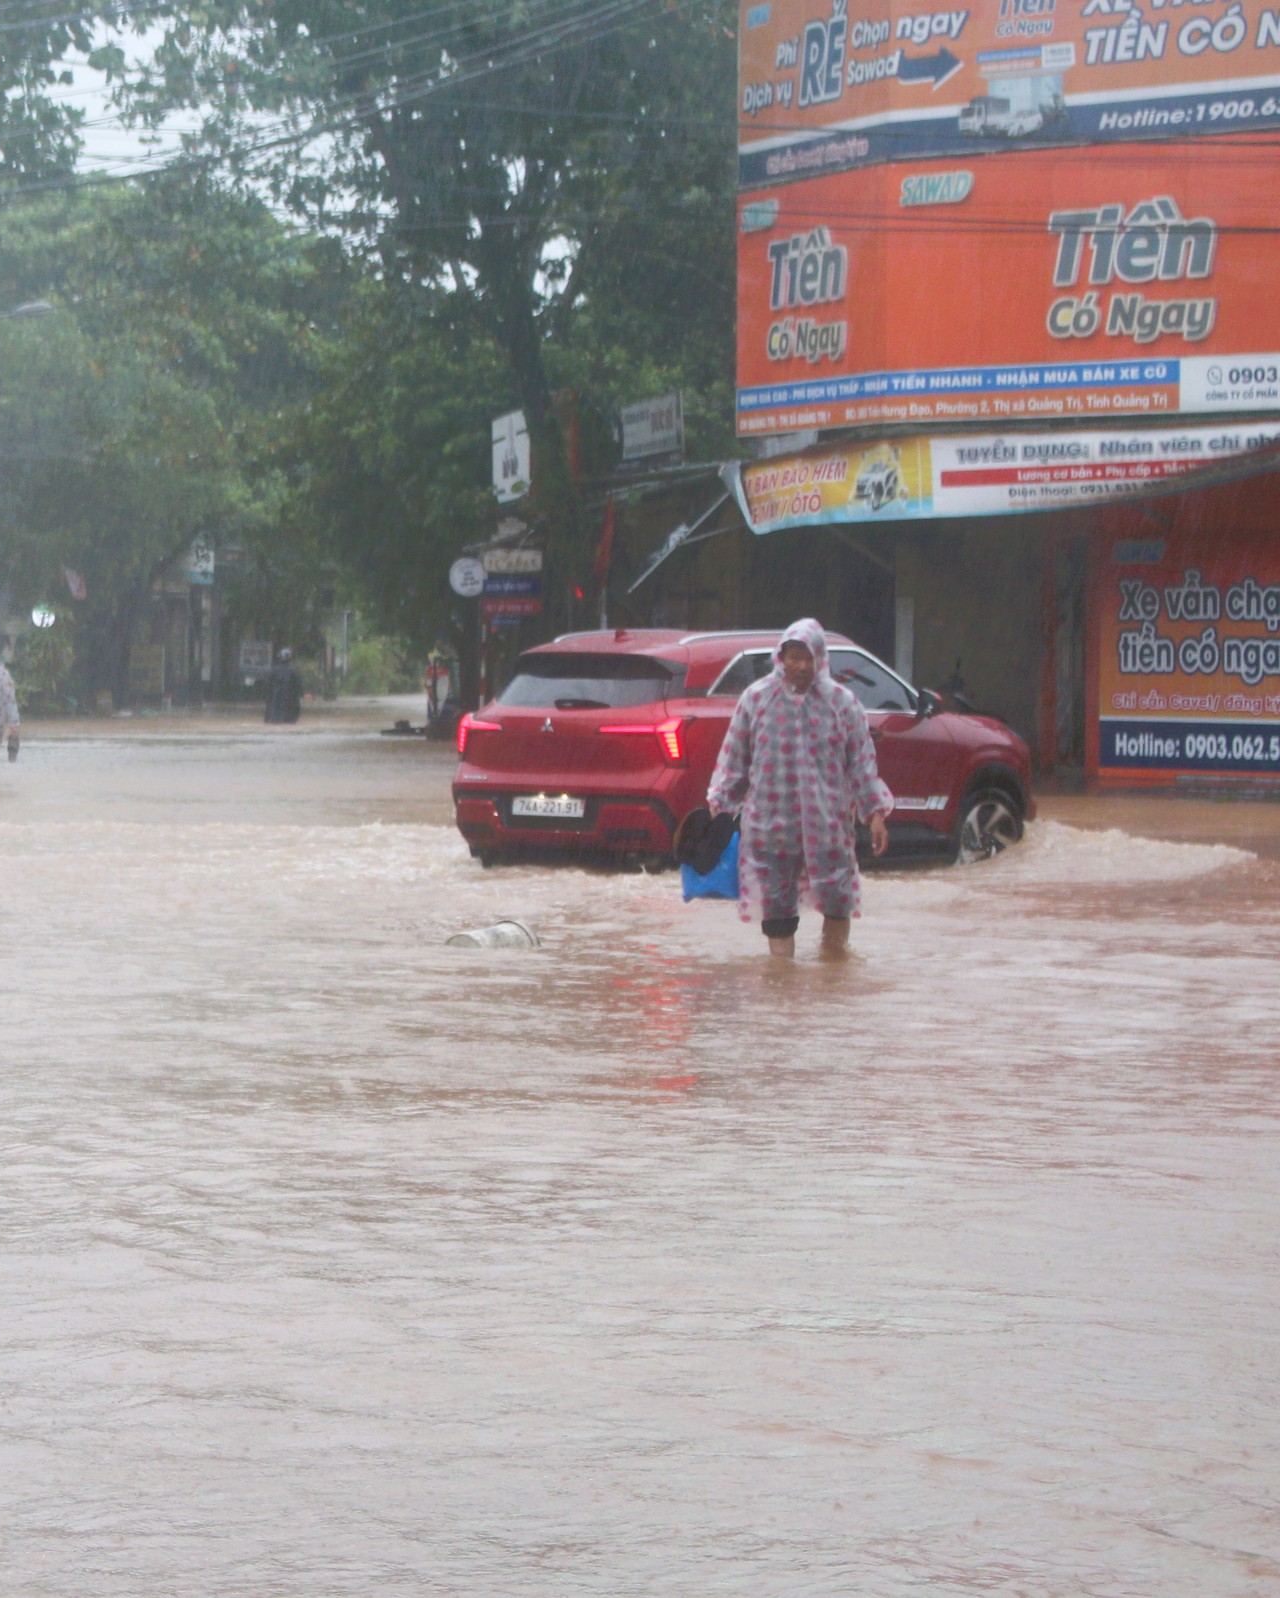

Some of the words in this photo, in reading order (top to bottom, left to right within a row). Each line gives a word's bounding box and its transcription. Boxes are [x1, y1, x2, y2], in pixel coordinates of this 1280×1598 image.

[852, 19, 889, 48] Chọn
[896, 10, 969, 43] ngay
[1086, 8, 1168, 64] TIỀN
[1178, 3, 1247, 54] CÓ
[776, 36, 799, 69] Phí
[847, 49, 902, 85] Sawad
[743, 81, 773, 116] Dịch
[777, 79, 794, 108] vụ
[900, 172, 973, 205] SAWAD
[1048, 196, 1216, 287] Tiền
[768, 226, 847, 310] Tiền
[1047, 293, 1098, 338] Có
[1107, 295, 1216, 343] Ngay
[767, 317, 791, 360] Có
[795, 318, 847, 363] Ngay
[930, 375, 982, 388] NHANH
[997, 370, 1039, 388] NHẬN
[1044, 369, 1078, 383] MUA
[1083, 365, 1115, 381] BÁN
[1121, 366, 1139, 380] XE
[1144, 362, 1167, 378] CŨ
[910, 401, 933, 417] Đạo,
[936, 401, 978, 417] Phường
[981, 401, 990, 414] 2,
[993, 399, 1010, 415] Thị
[1028, 396, 1063, 413] Quảng
[1067, 396, 1083, 411] Trị,
[1087, 394, 1110, 409] Tỉnh
[1113, 393, 1149, 410] Quảng
[1152, 392, 1168, 409] Trị
[957, 438, 1017, 464] TUYỂN
[1023, 443, 1090, 464] DỤNG:
[1100, 436, 1153, 456] Nhân
[1160, 436, 1202, 454] viên
[1120, 579, 1159, 620] Xe
[1165, 569, 1220, 620] vẫn
[1119, 622, 1173, 673] tiền
[1179, 628, 1220, 674] có
[1115, 732, 1180, 758] Hotline:
